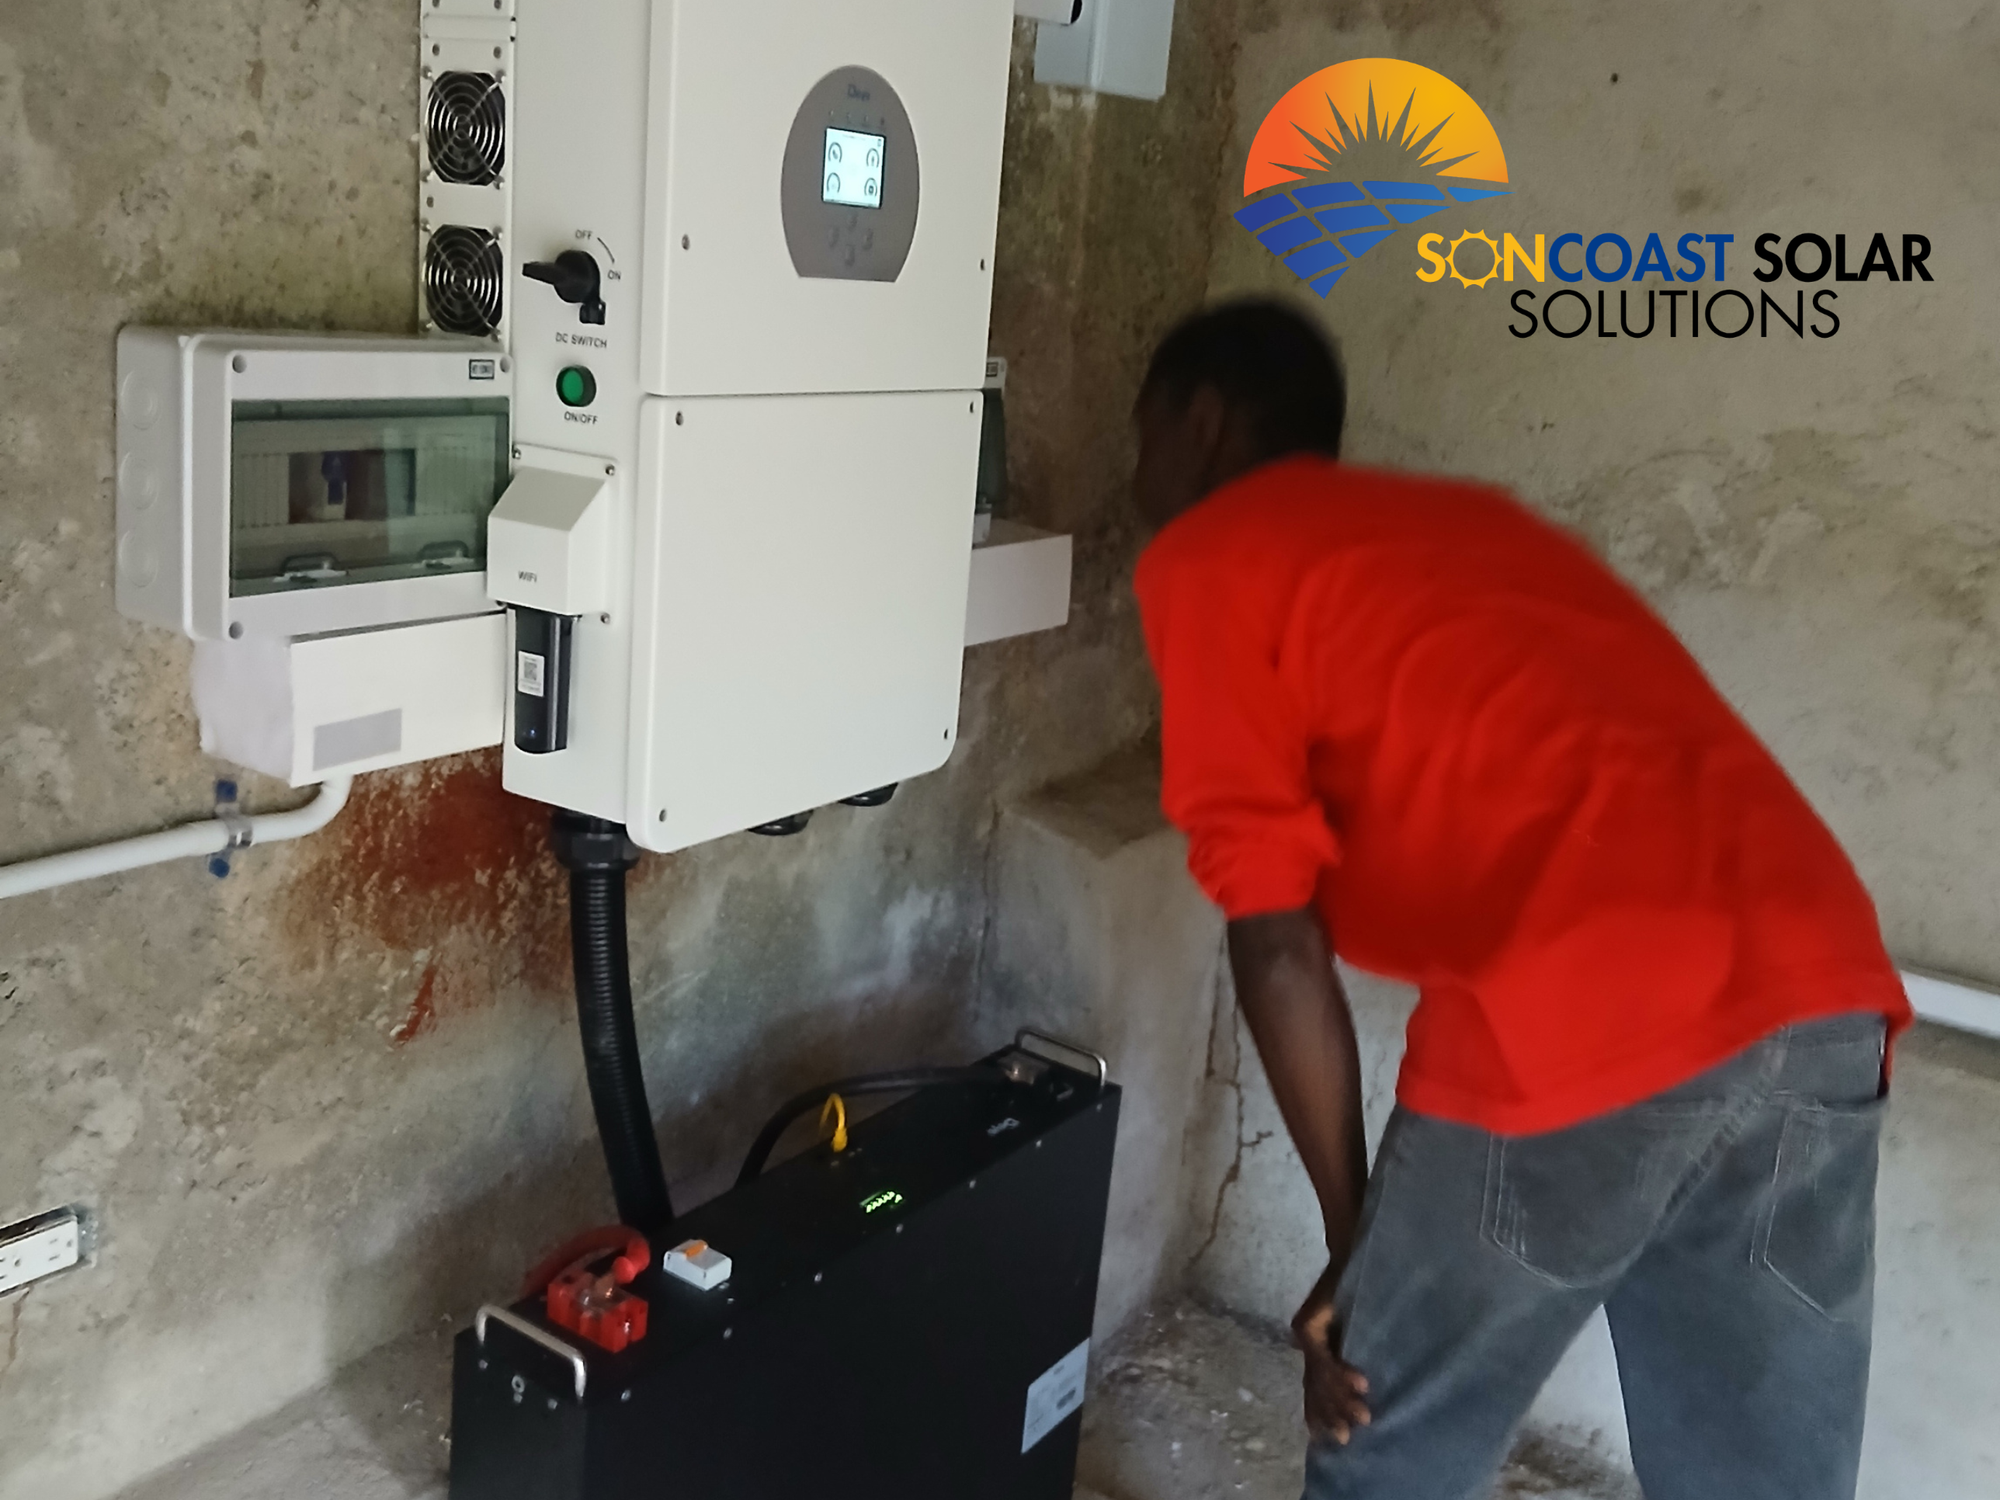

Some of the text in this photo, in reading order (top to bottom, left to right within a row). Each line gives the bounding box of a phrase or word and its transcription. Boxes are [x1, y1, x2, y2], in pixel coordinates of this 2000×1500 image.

[575, 229, 593, 240] OFF
[607, 269, 621, 281] ON
[555, 332, 607, 348] DC SWITCH
[564, 411, 598, 425] ON/OFF
